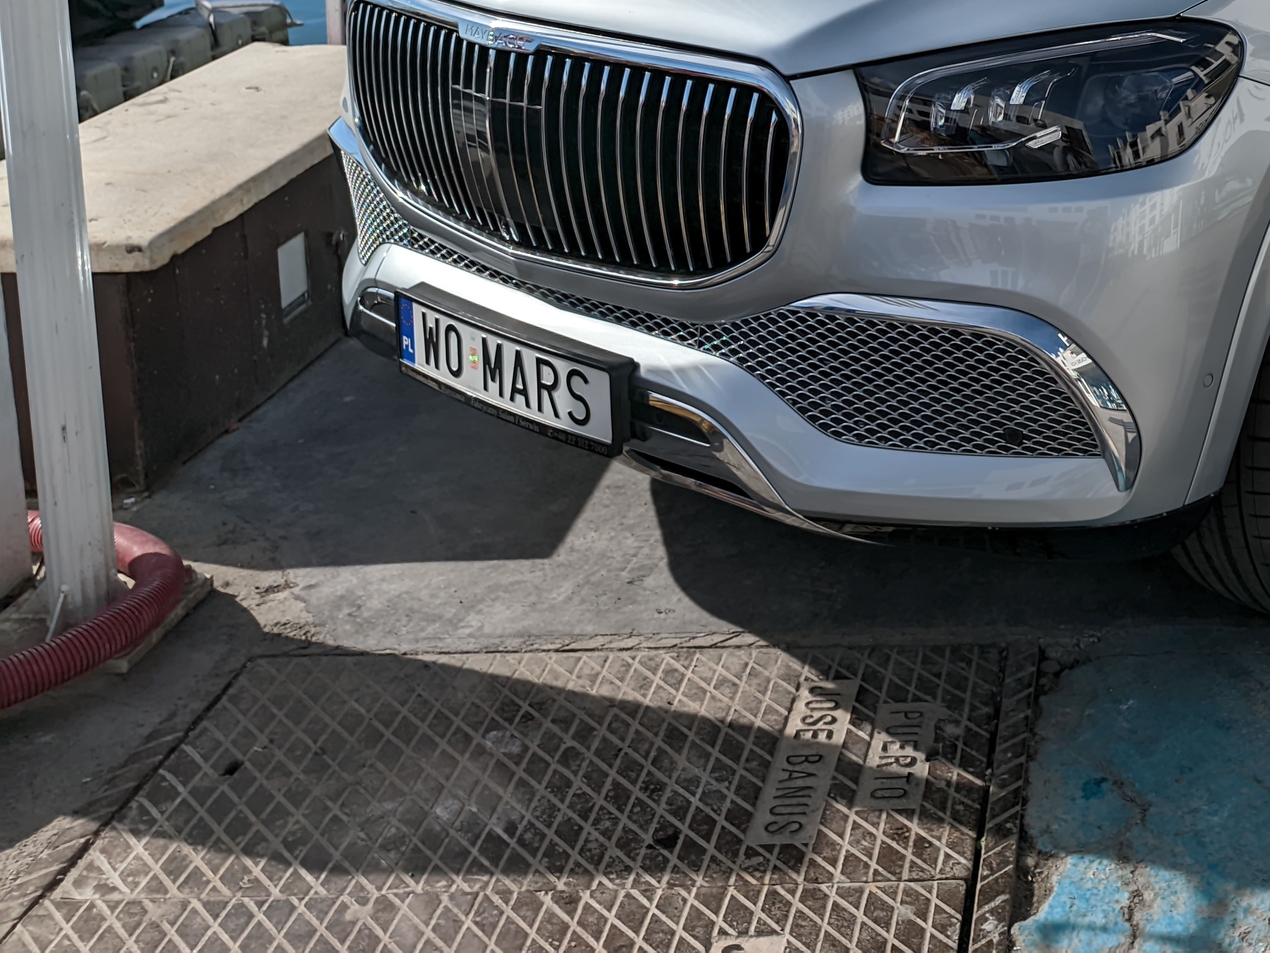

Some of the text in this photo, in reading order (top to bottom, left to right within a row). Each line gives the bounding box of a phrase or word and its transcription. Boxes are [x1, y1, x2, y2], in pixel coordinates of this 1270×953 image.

[403, 335, 414, 353] PL
[421, 310, 591, 427] WO MARS
[763, 685, 841, 835] JOSE BANUS
[870, 710, 924, 799] PUERTO
